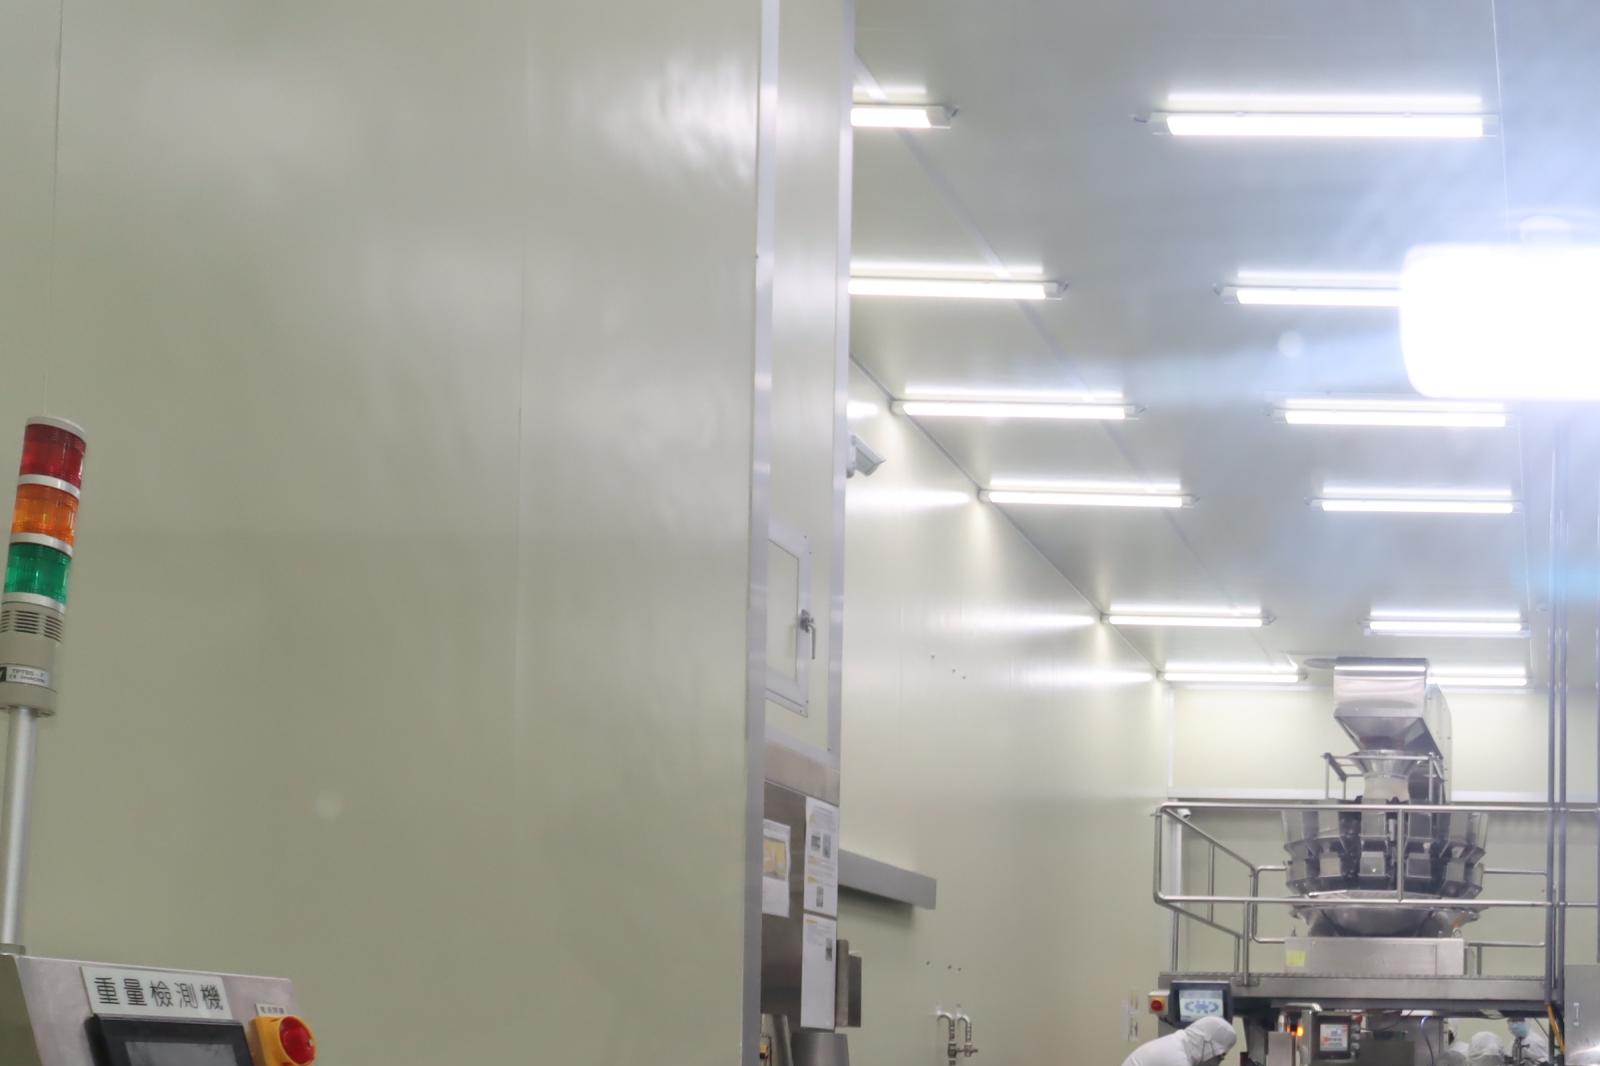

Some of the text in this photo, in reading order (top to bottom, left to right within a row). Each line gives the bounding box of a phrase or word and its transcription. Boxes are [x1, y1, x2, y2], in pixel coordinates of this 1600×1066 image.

[94, 976, 224, 1011] 重量檢測機
